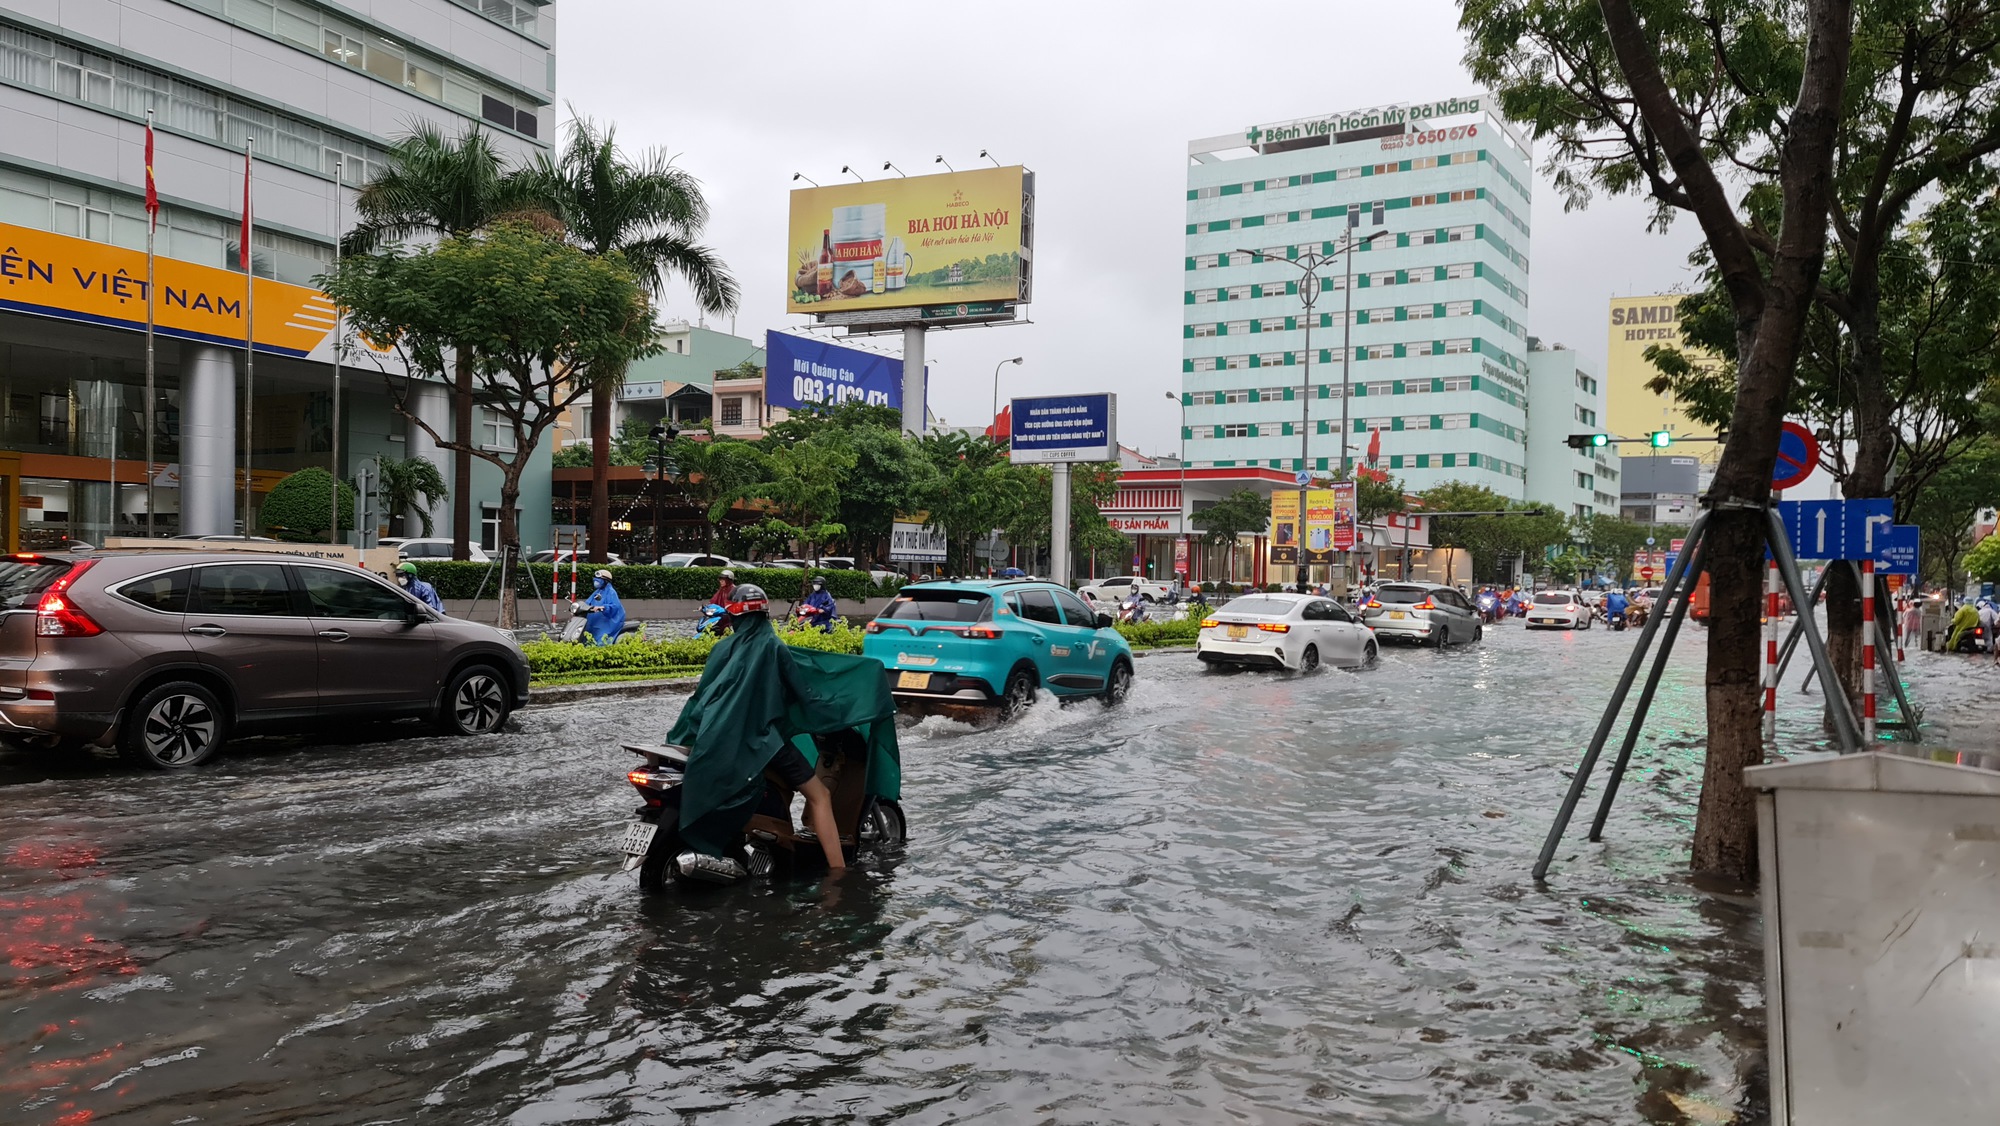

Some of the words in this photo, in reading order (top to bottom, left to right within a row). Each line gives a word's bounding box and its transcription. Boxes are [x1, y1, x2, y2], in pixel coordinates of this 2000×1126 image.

[1265, 127, 1300, 142] Bệnh
[1304, 120, 1337, 136] Viện
[1339, 113, 1379, 131] Hoàn
[1382, 108, 1406, 125] Mỹ
[1409, 104, 1432, 119] Đà
[1435, 97, 1480, 116] Nẵng
[1405, 133, 1415, 147] 3
[1417, 129, 1447, 145] 650
[1448, 124, 1478, 140] 676
[946, 200, 970, 208] HABECO
[907, 218, 931, 235] BIA
[932, 215, 959, 232] HƠI
[961, 209, 982, 229] HÀ
[983, 208, 1010, 230] NỘI
[920, 237, 935, 249] Một
[971, 232, 983, 243] Hà
[983, 231, 995, 243] Nội
[842, 247, 858, 258] HƠI
[859, 243, 872, 257] HÀ
[72, 268, 152, 304] VIỆT
[165, 285, 241, 319] NAM
[1625, 327, 1677, 341] HOTEL
[793, 358, 810, 374] Mời
[811, 362, 838, 381] Quảng
[839, 367, 855, 383] Cáo
[1124, 517, 1141, 530] SẢN
[1143, 515, 1169, 530] PHẨM
